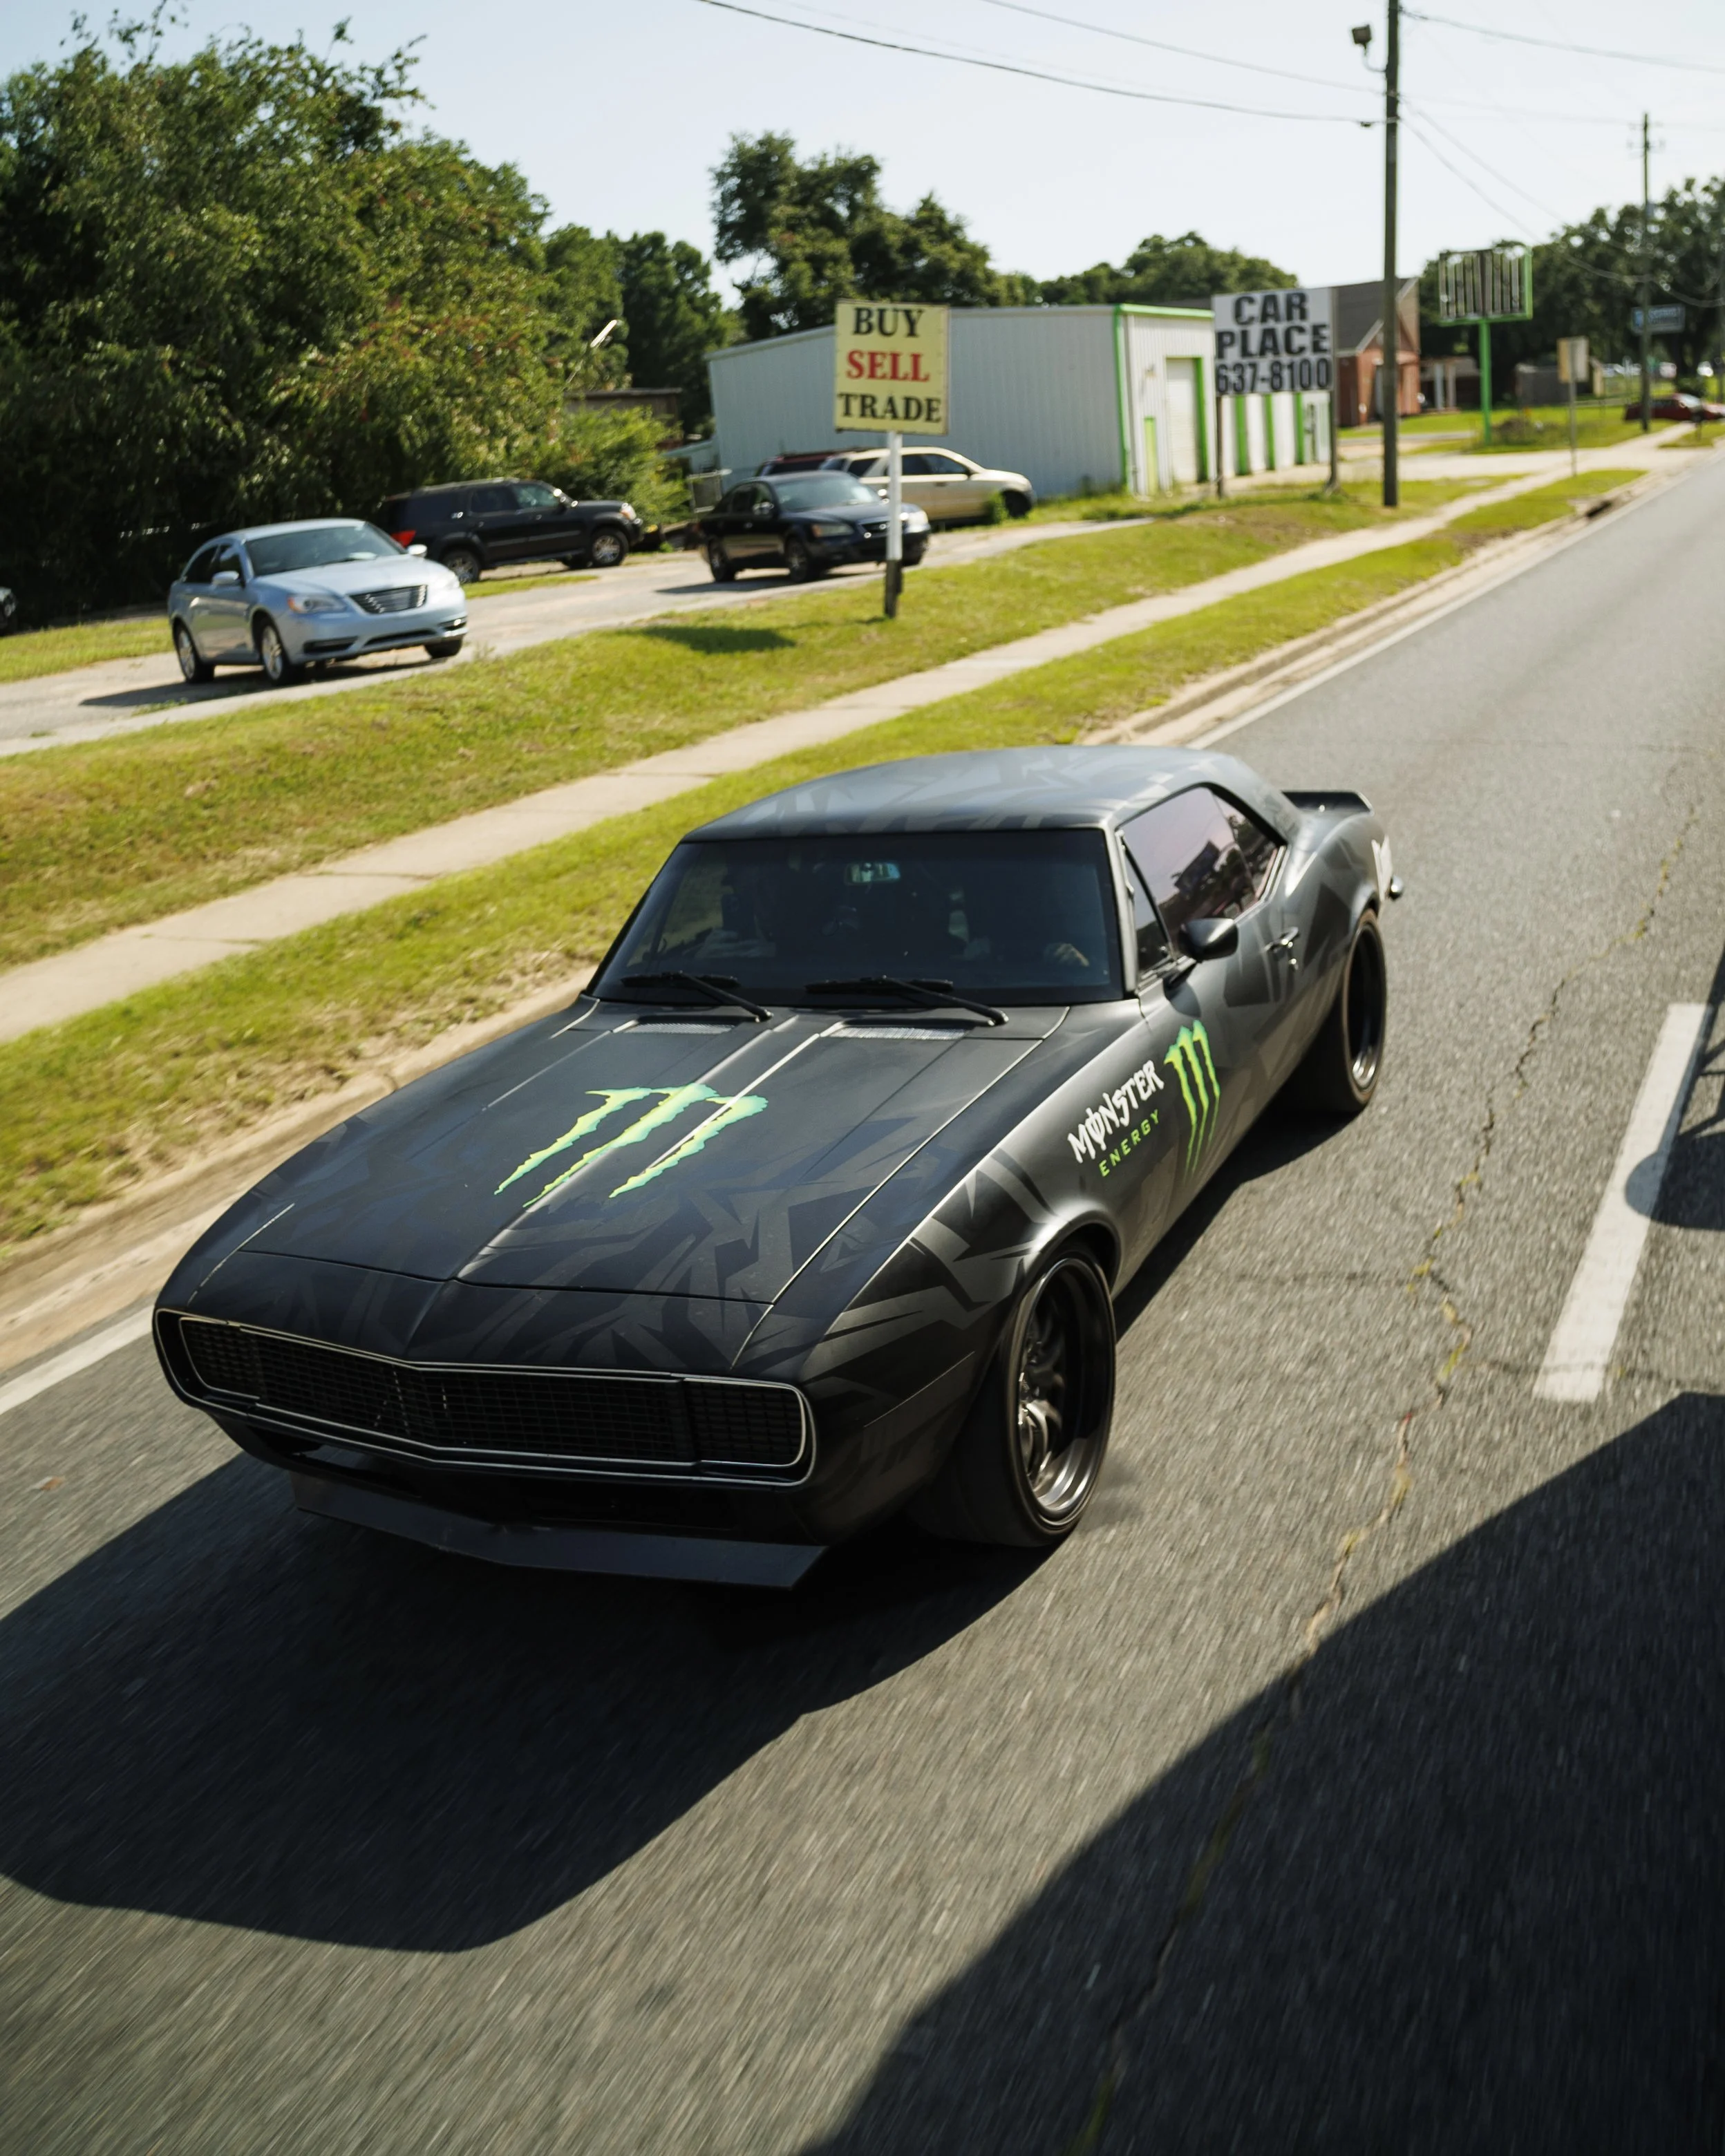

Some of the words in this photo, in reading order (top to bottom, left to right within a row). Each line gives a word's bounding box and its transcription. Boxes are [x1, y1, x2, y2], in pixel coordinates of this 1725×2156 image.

[852, 307, 924, 337] BUY
[1234, 293, 1308, 325] CAR
[1217, 325, 1329, 359] PLACE
[846, 350, 930, 382] SELL
[1217, 358, 1330, 393] 637-8100
[838, 393, 942, 424] TRADE
[1098, 1109, 1159, 1177] ENERGY
